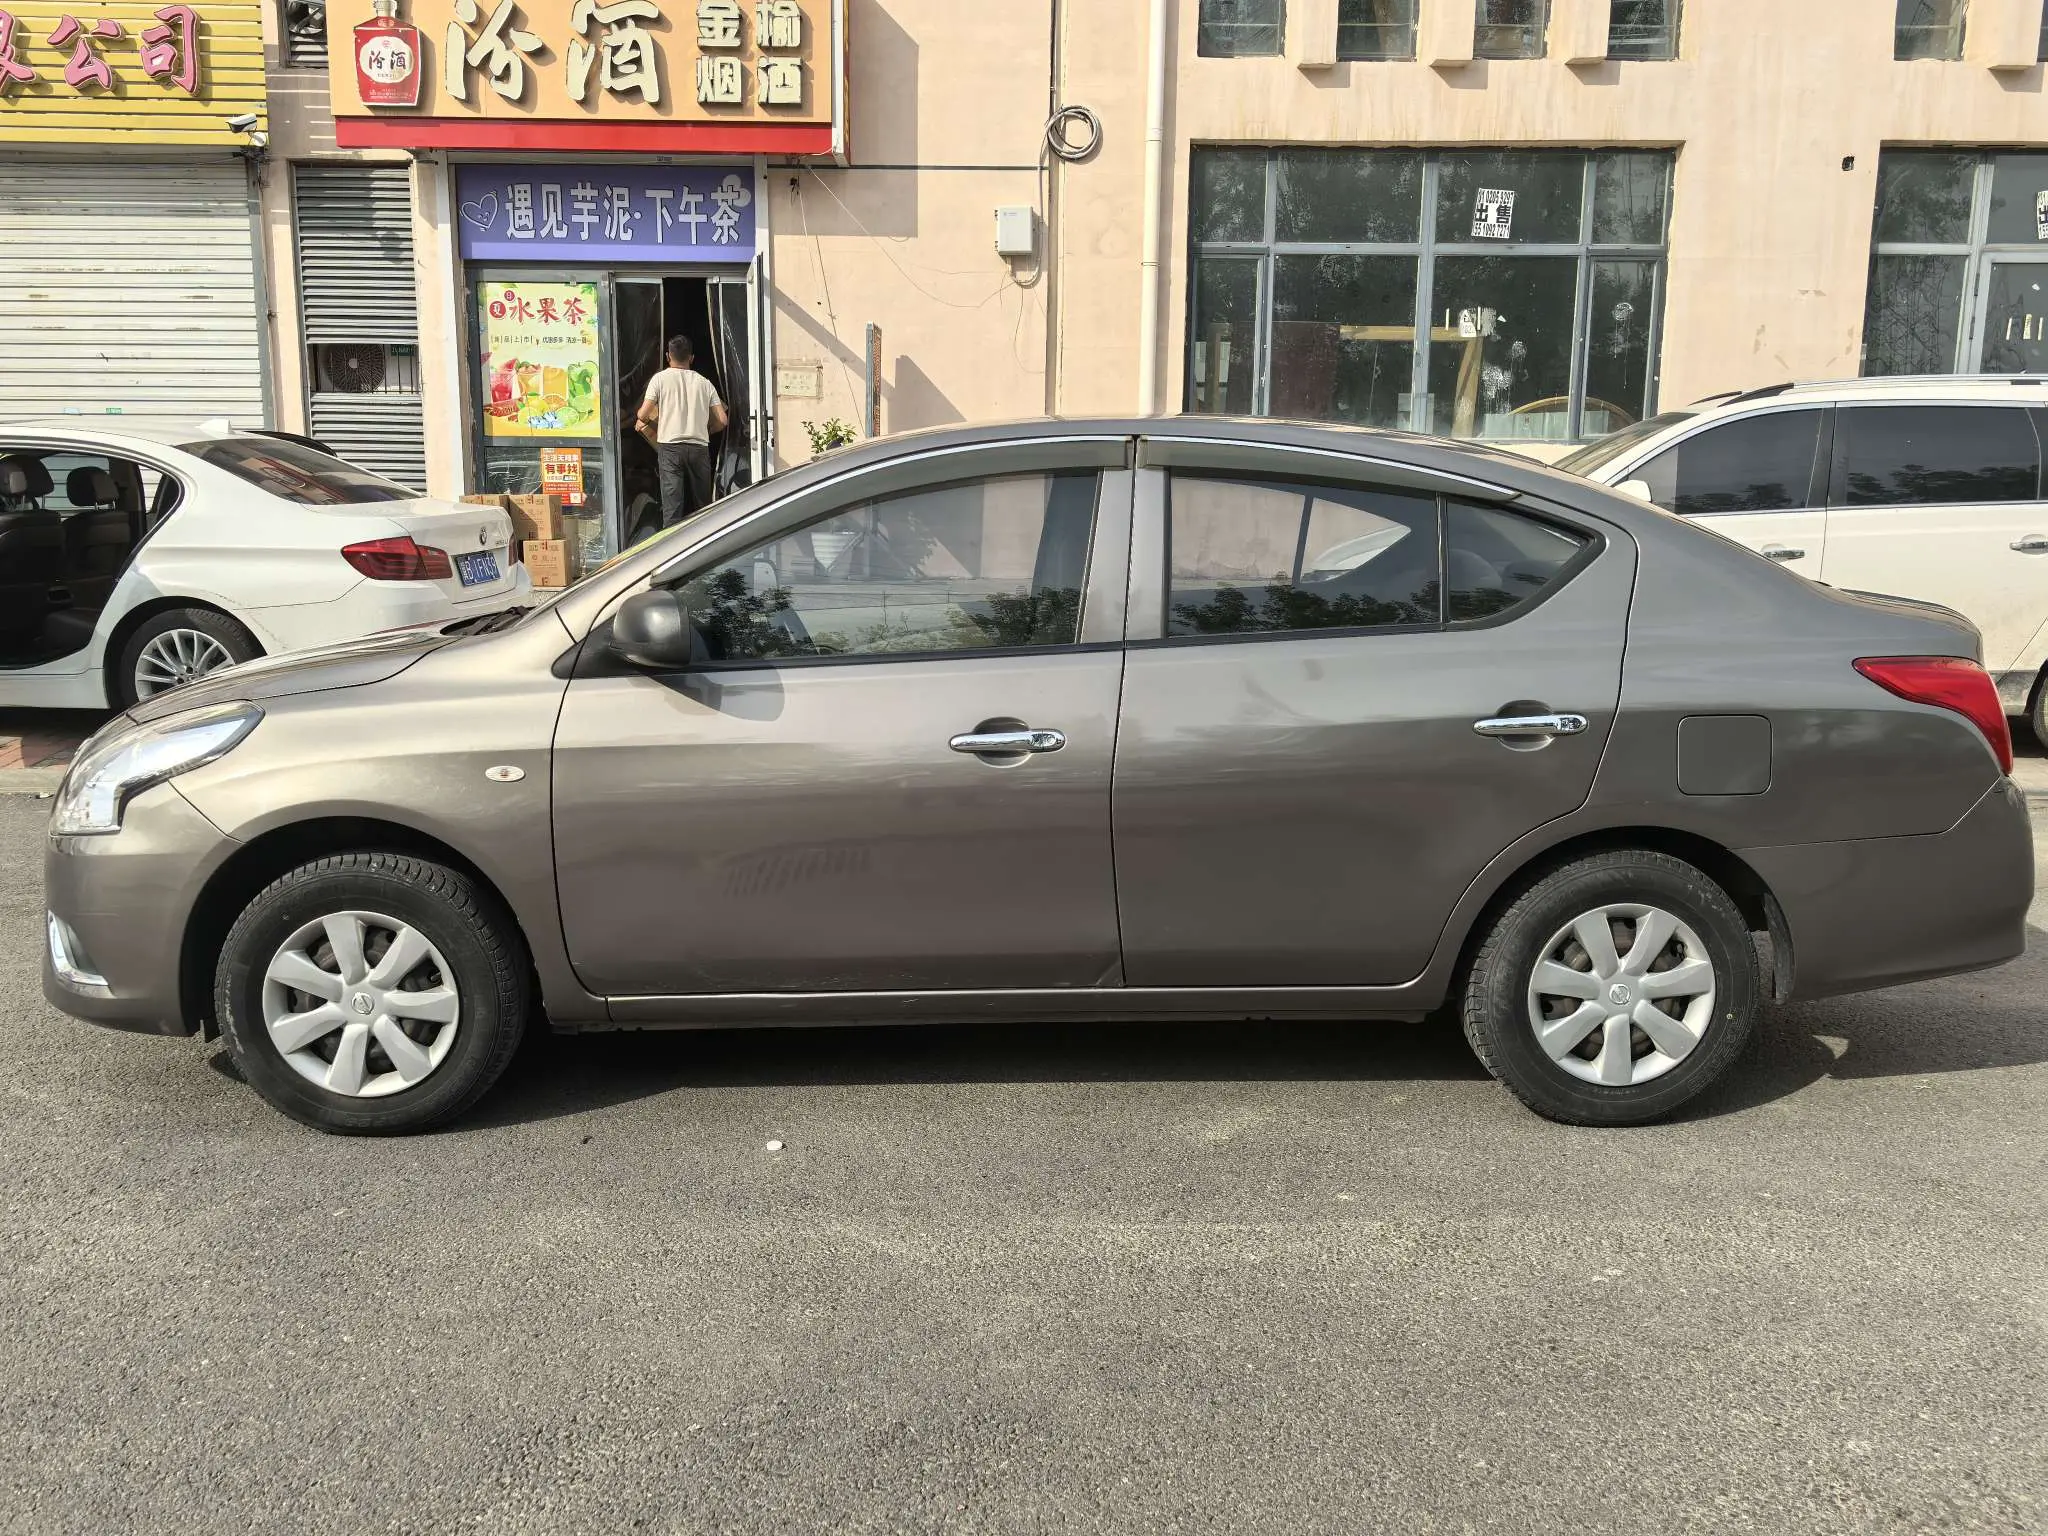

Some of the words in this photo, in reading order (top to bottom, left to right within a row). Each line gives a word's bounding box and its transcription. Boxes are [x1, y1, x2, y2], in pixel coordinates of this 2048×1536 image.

[368, 50, 407, 70] 汾酒
[445, 0, 659, 103] 汾酒
[696, 55, 803, 104] 烟酒
[1475, 202, 1512, 224] 出售
